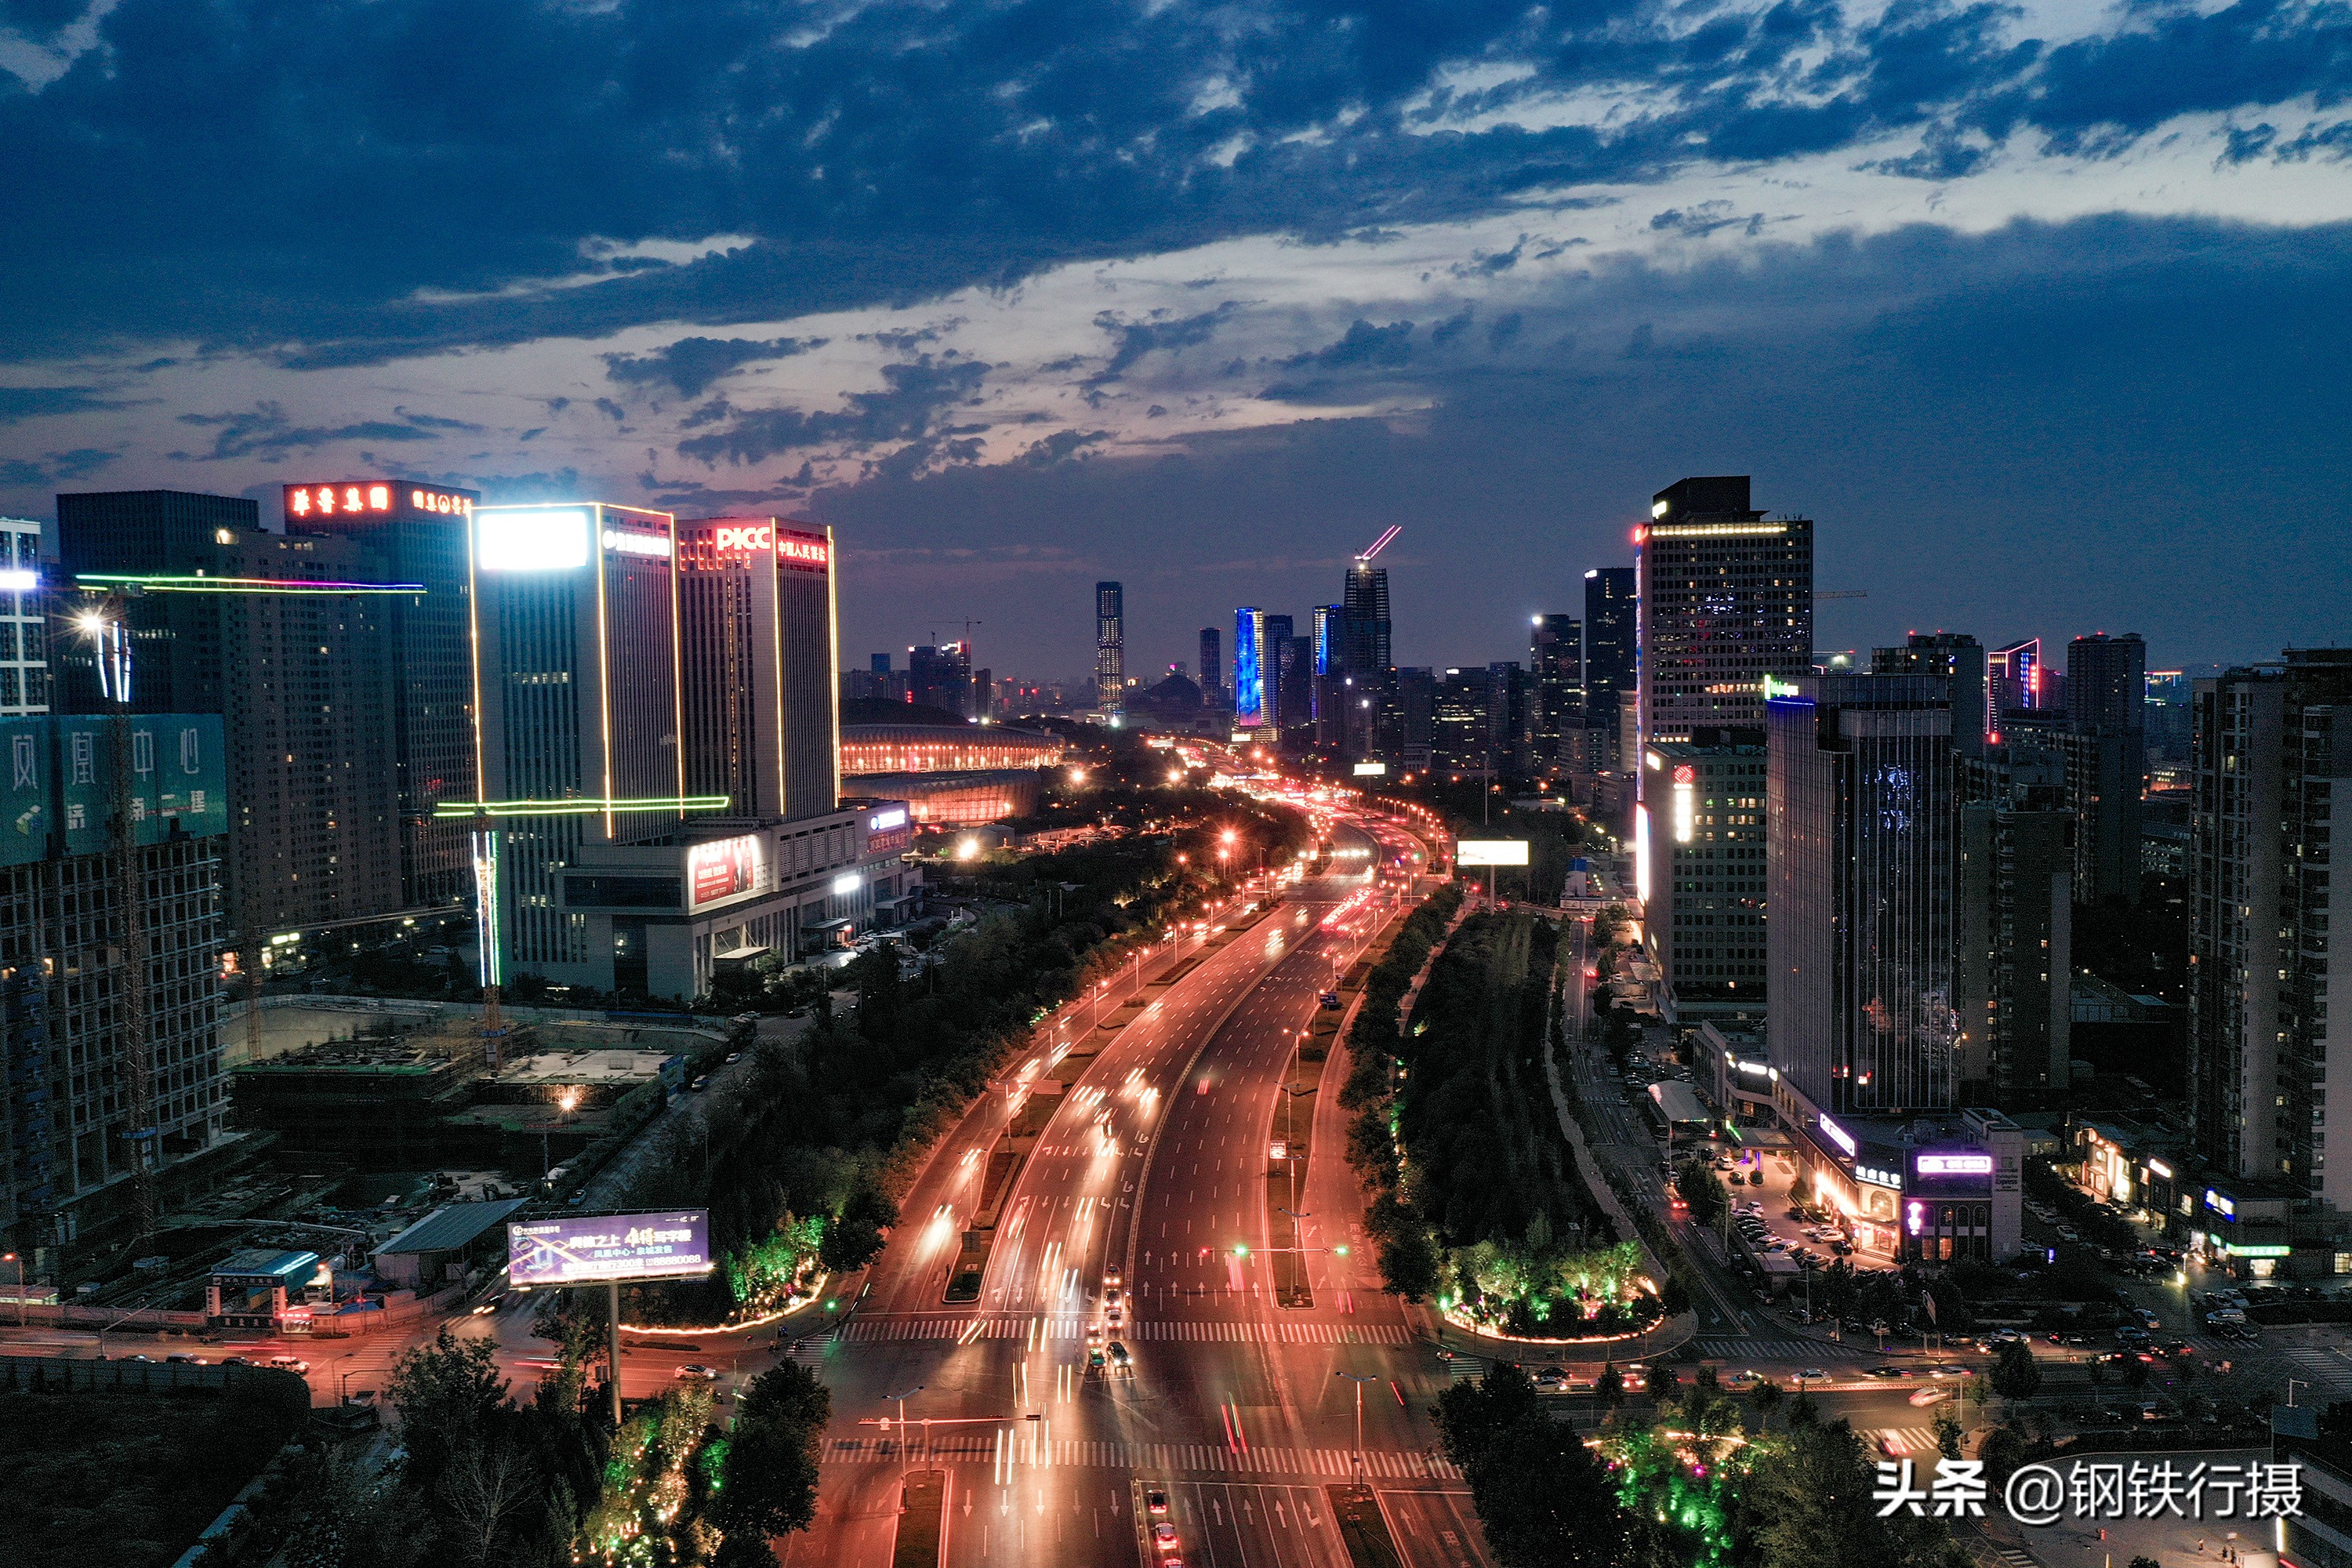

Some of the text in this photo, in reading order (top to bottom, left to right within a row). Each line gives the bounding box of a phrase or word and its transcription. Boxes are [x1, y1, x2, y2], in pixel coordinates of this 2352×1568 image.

[717, 526, 771, 550] PICC
[778, 540, 826, 561] 中国人民保险
[12, 728, 199, 791] 凤凰中心
